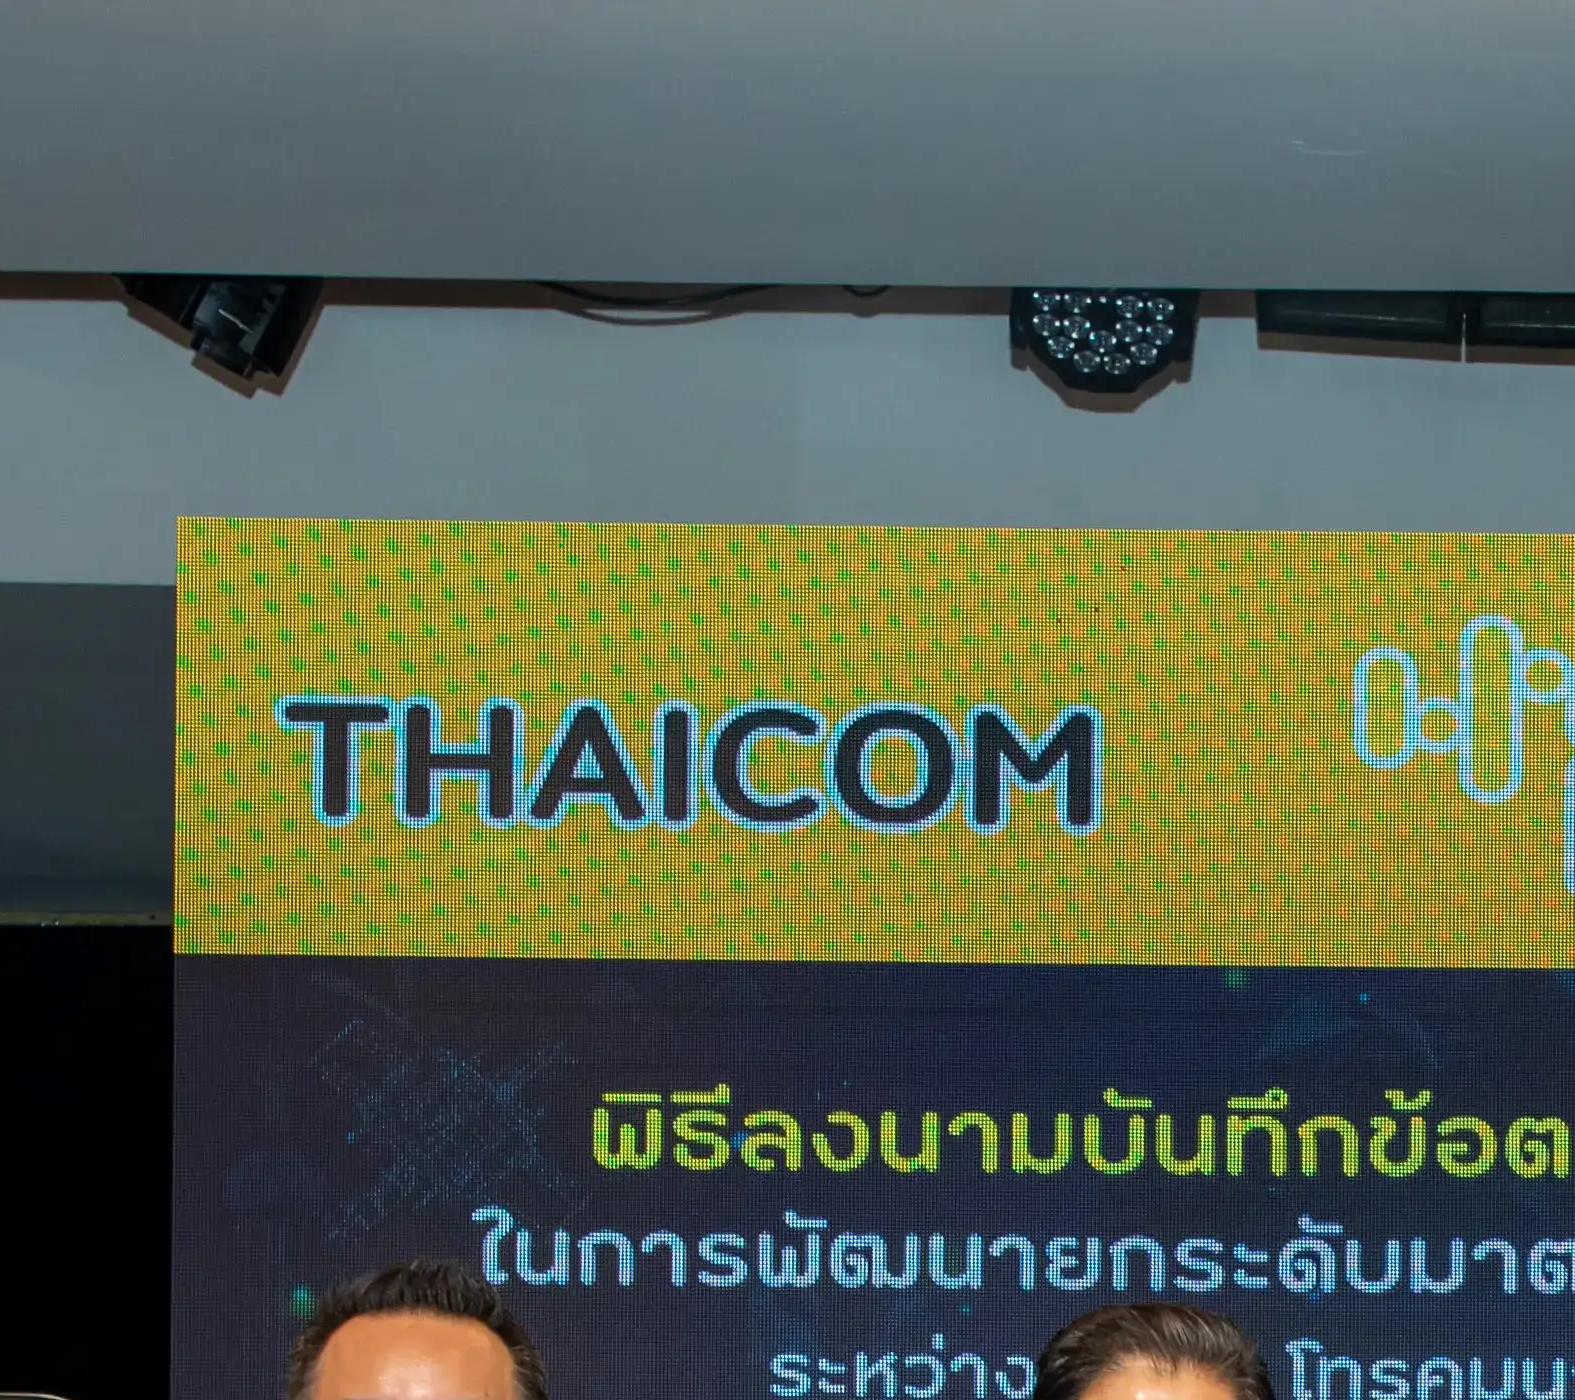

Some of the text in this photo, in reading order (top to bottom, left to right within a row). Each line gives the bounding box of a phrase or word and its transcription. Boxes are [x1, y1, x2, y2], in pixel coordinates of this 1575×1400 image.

[284, 702, 1098, 828] THAICOM
[770, 1333, 1038, 1399] ระหว่าง
